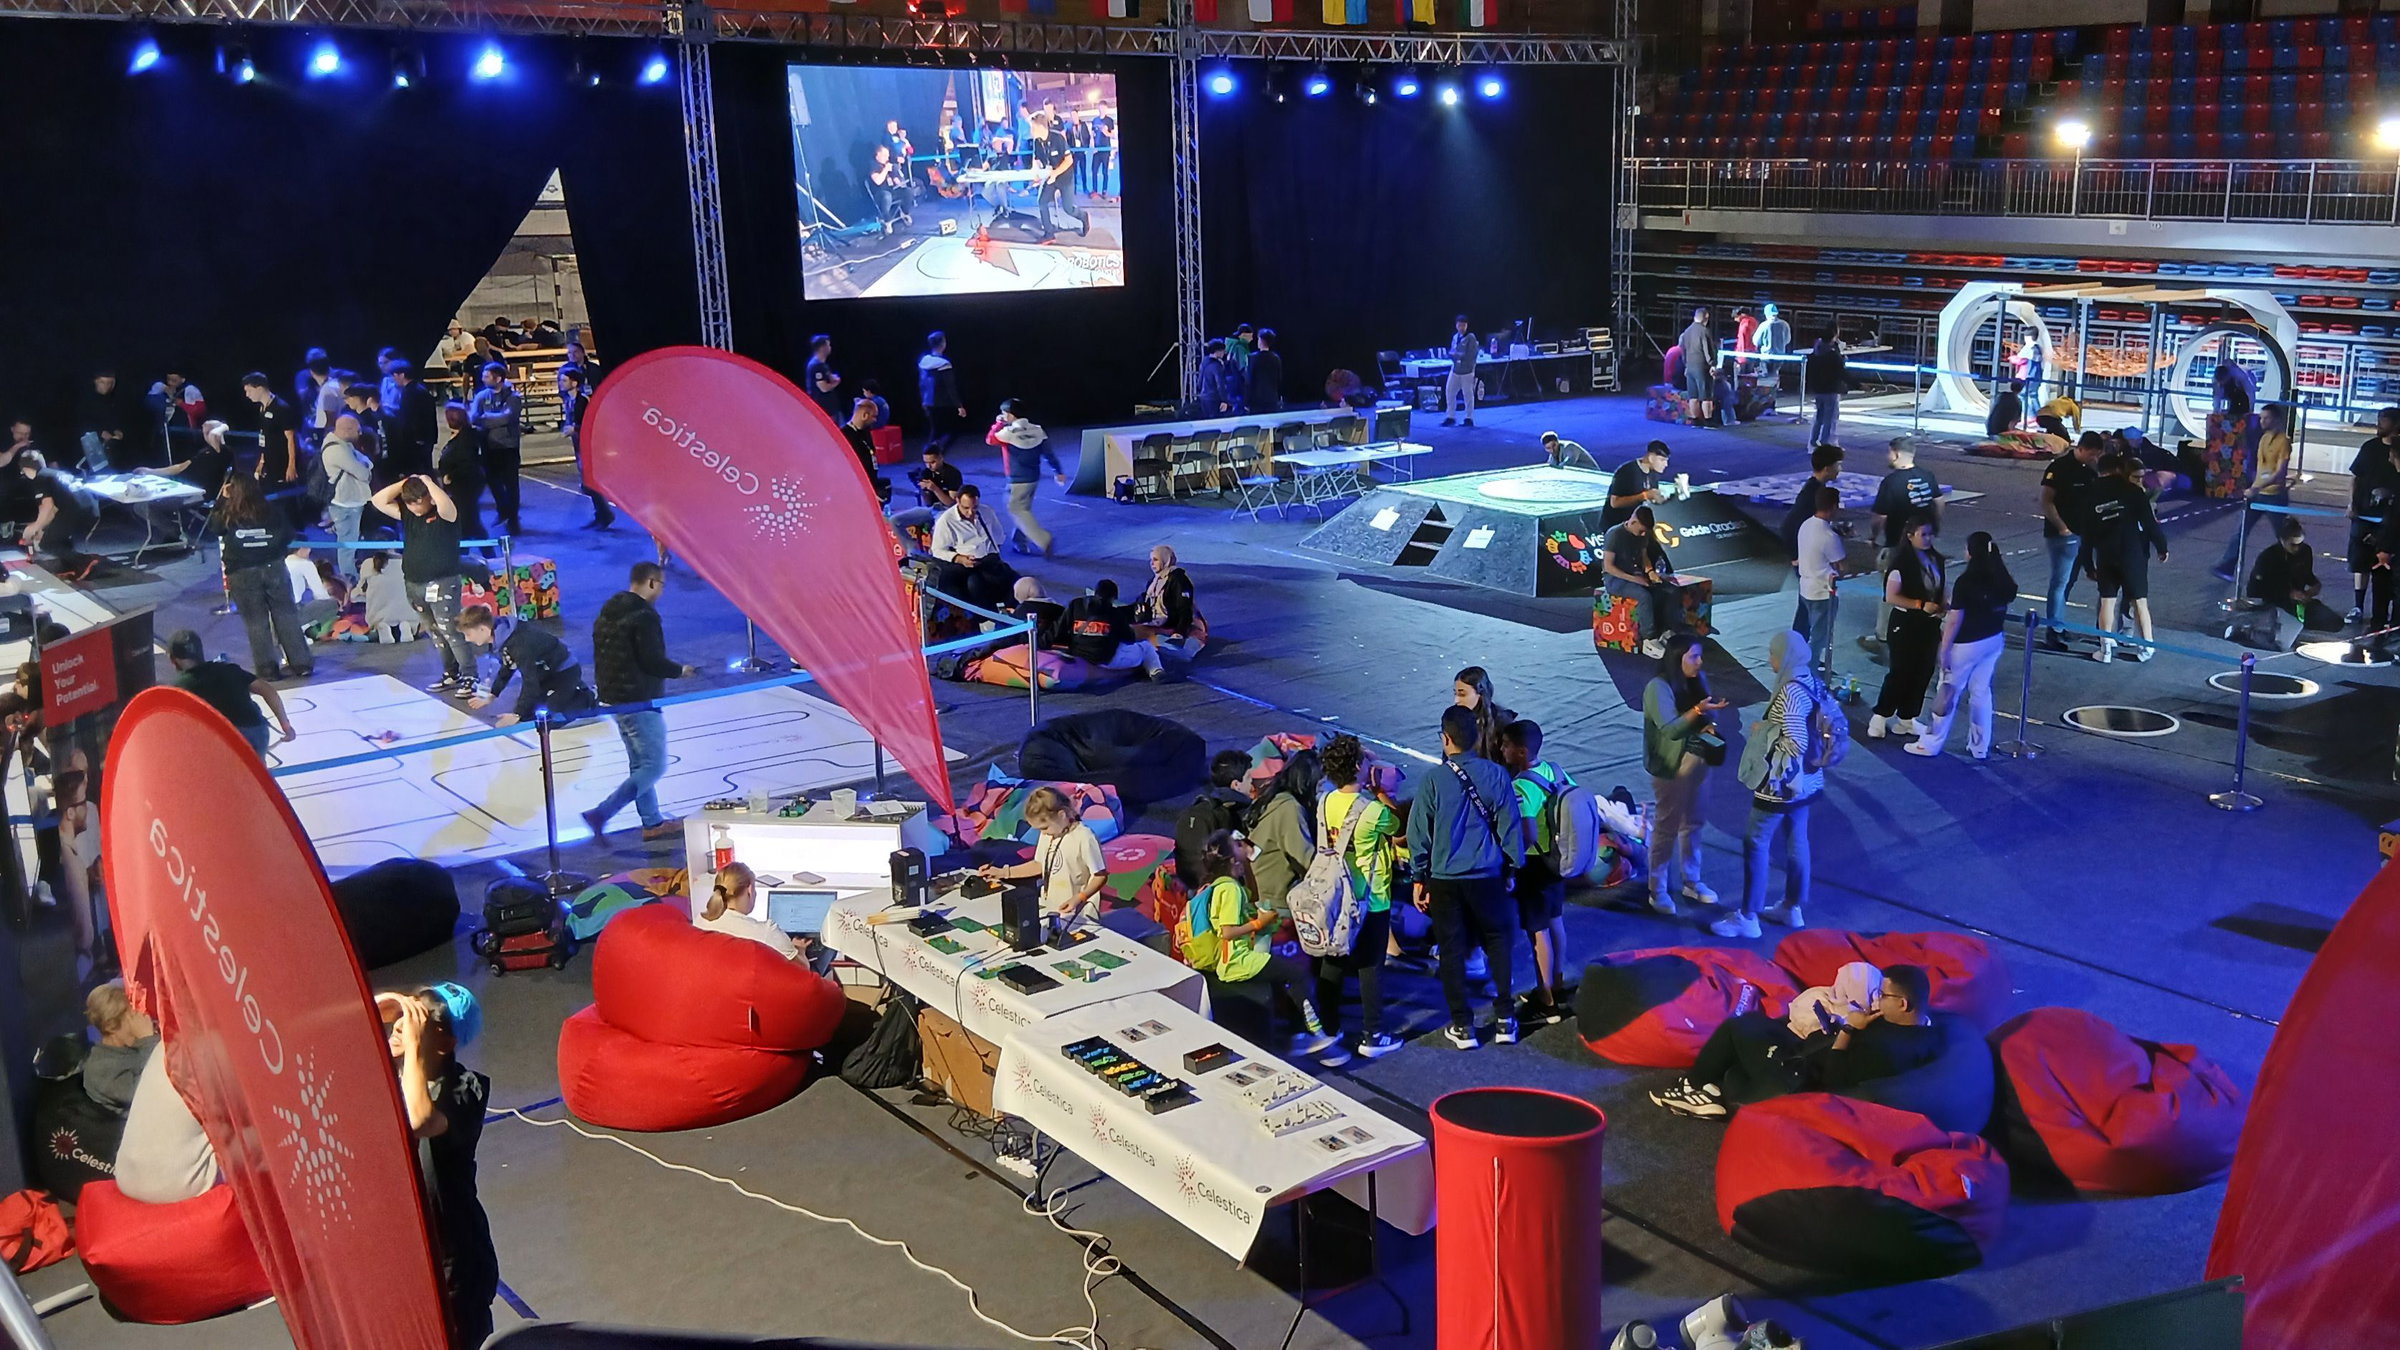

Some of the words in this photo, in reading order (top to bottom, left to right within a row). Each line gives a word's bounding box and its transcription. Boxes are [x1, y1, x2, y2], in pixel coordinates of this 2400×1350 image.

[1584, 532, 1605, 547] Vis
[52, 654, 84, 674] Unlock
[54, 675, 76, 689] Your
[853, 918, 889, 948] Celesica
[919, 955, 956, 988] Celestica
[1033, 1078, 1074, 1115] Celestica
[72, 1147, 118, 1178] Celesti
[1108, 1127, 1156, 1167] Celestica
[1197, 1181, 1251, 1225] Celestica
